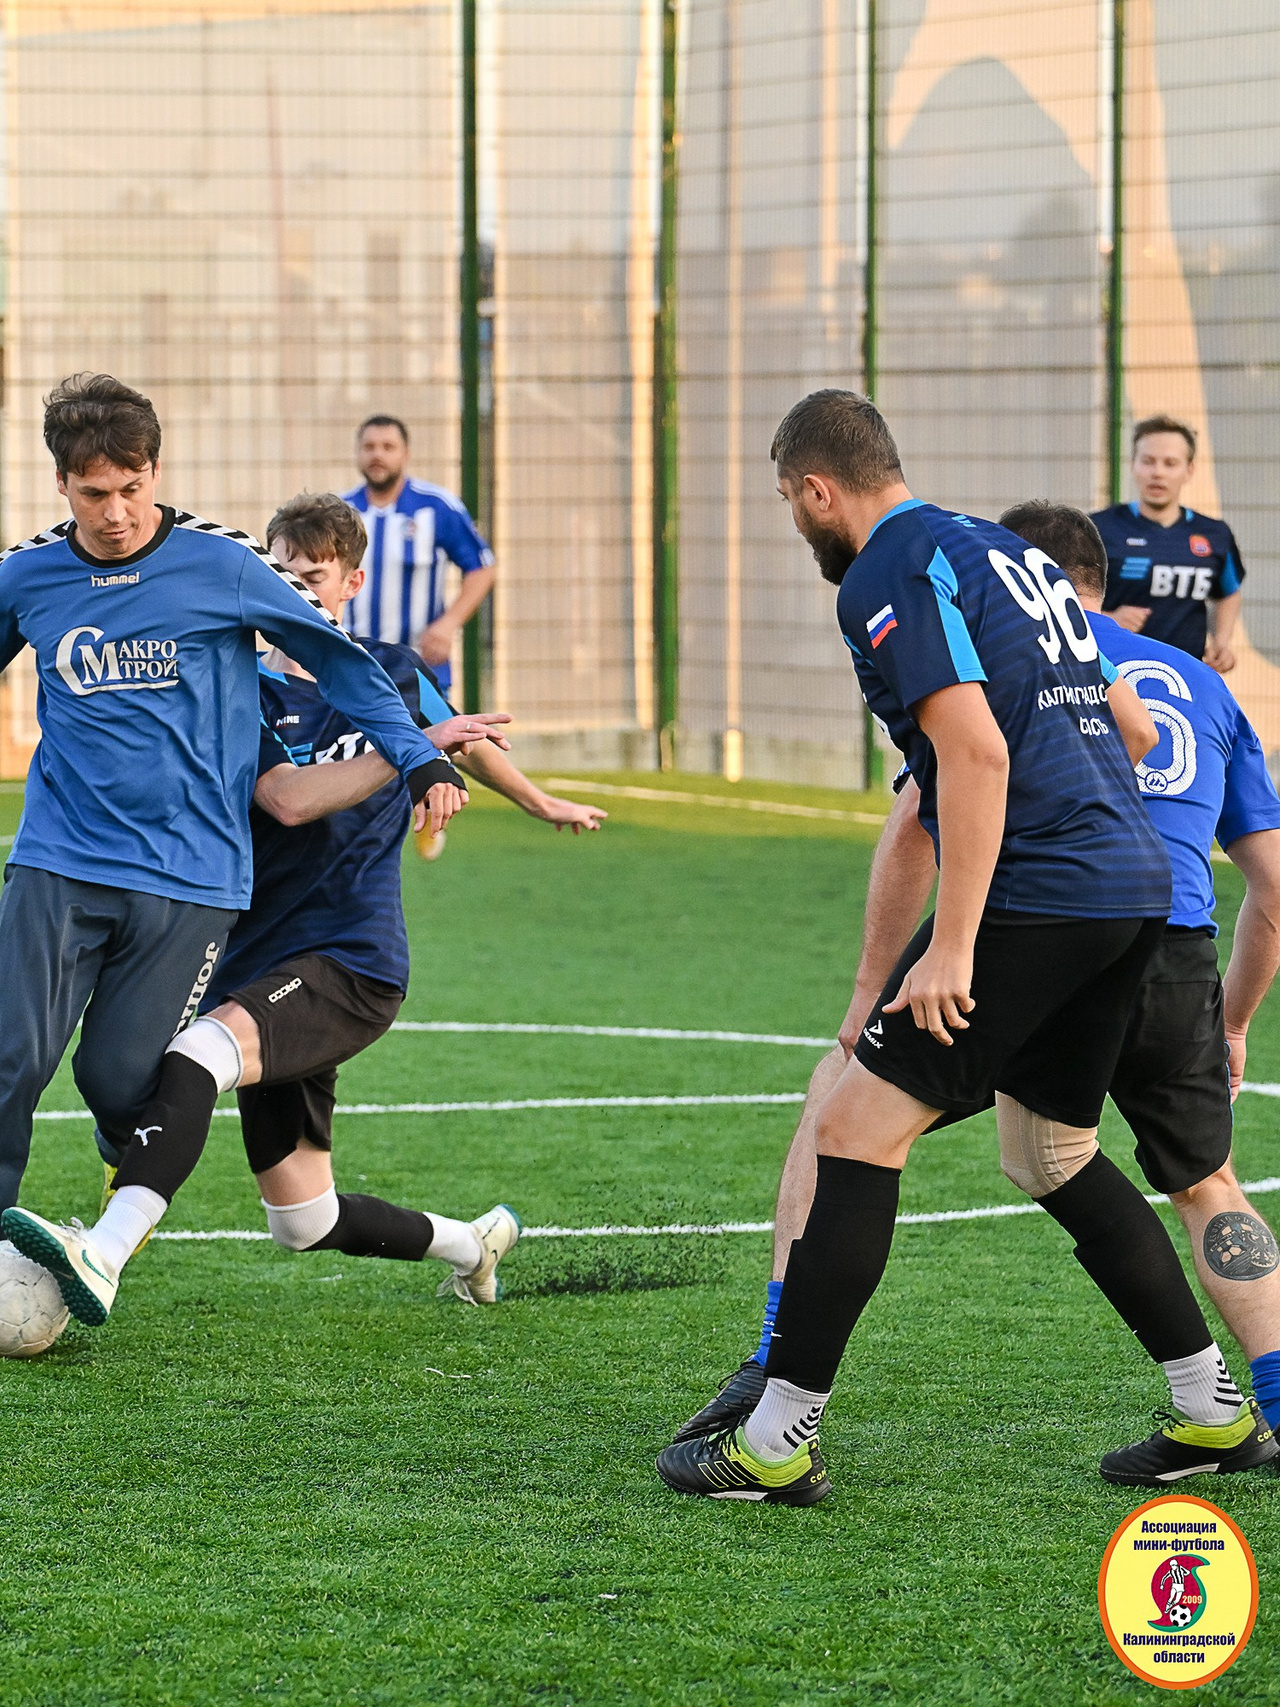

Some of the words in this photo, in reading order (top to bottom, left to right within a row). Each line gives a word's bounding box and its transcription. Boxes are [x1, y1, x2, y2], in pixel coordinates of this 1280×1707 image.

[91, 572, 140, 587] hummel
[987, 547, 1099, 665] 96
[1149, 564, 1213, 600] ВТБ
[1116, 659, 1198, 796] 6
